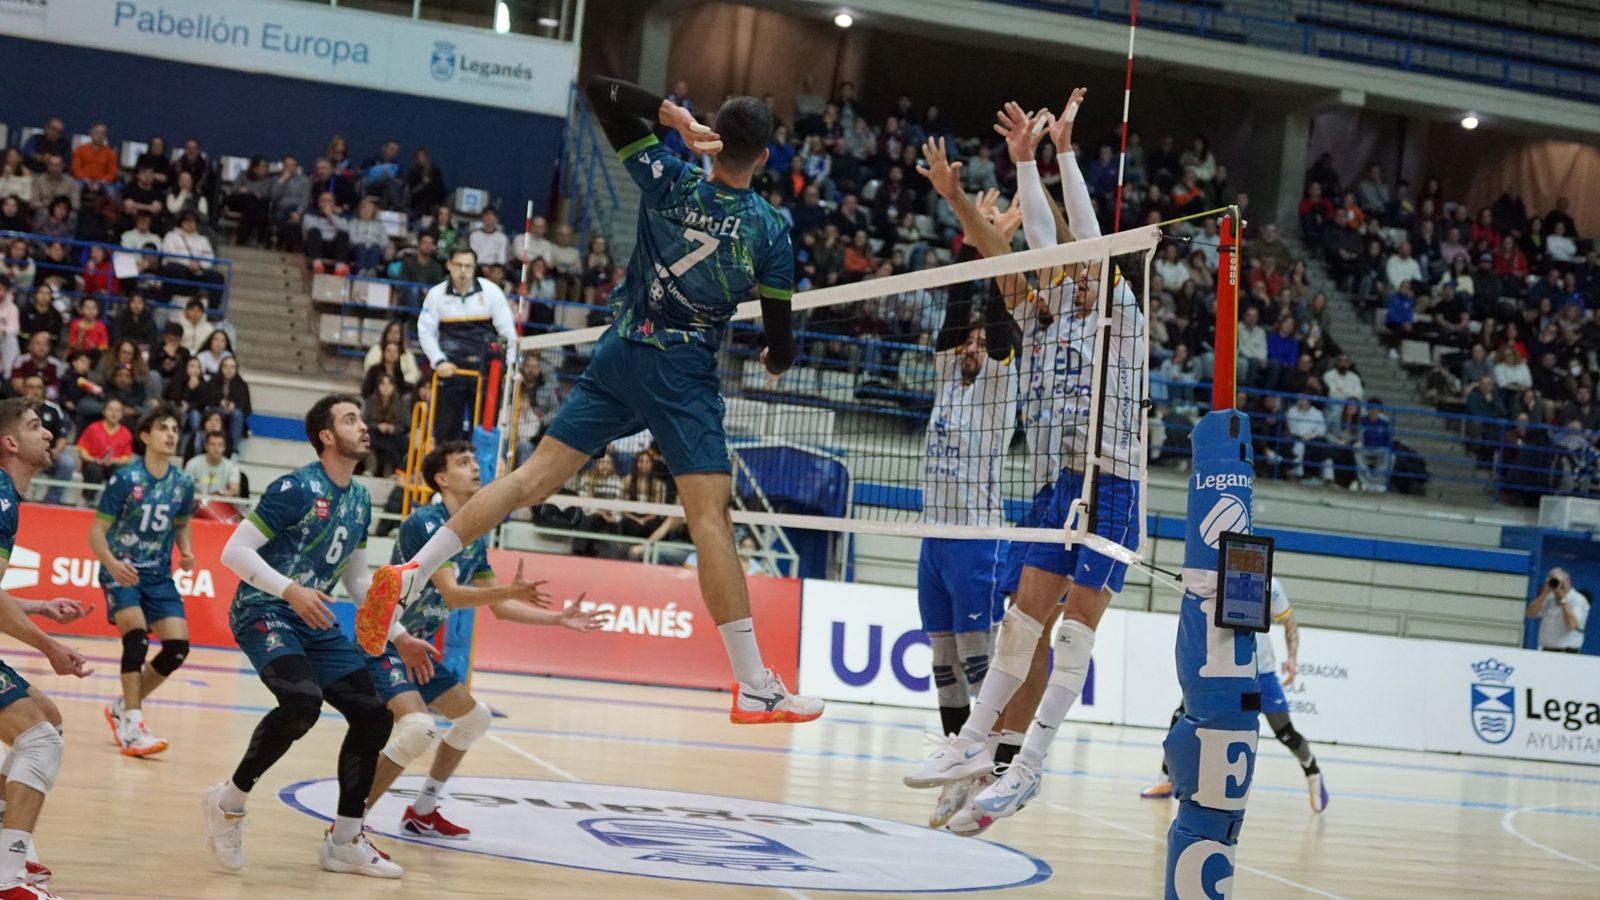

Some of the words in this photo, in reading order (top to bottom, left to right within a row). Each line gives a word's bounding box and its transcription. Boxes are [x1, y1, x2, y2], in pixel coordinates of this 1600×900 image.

[114, 1, 249, 46] Pabellón
[261, 23, 369, 64] Europa
[460, 55, 533, 79] Leganés
[655, 228, 720, 278] 7
[139, 503, 170, 532] 15
[325, 525, 349, 564] 6
